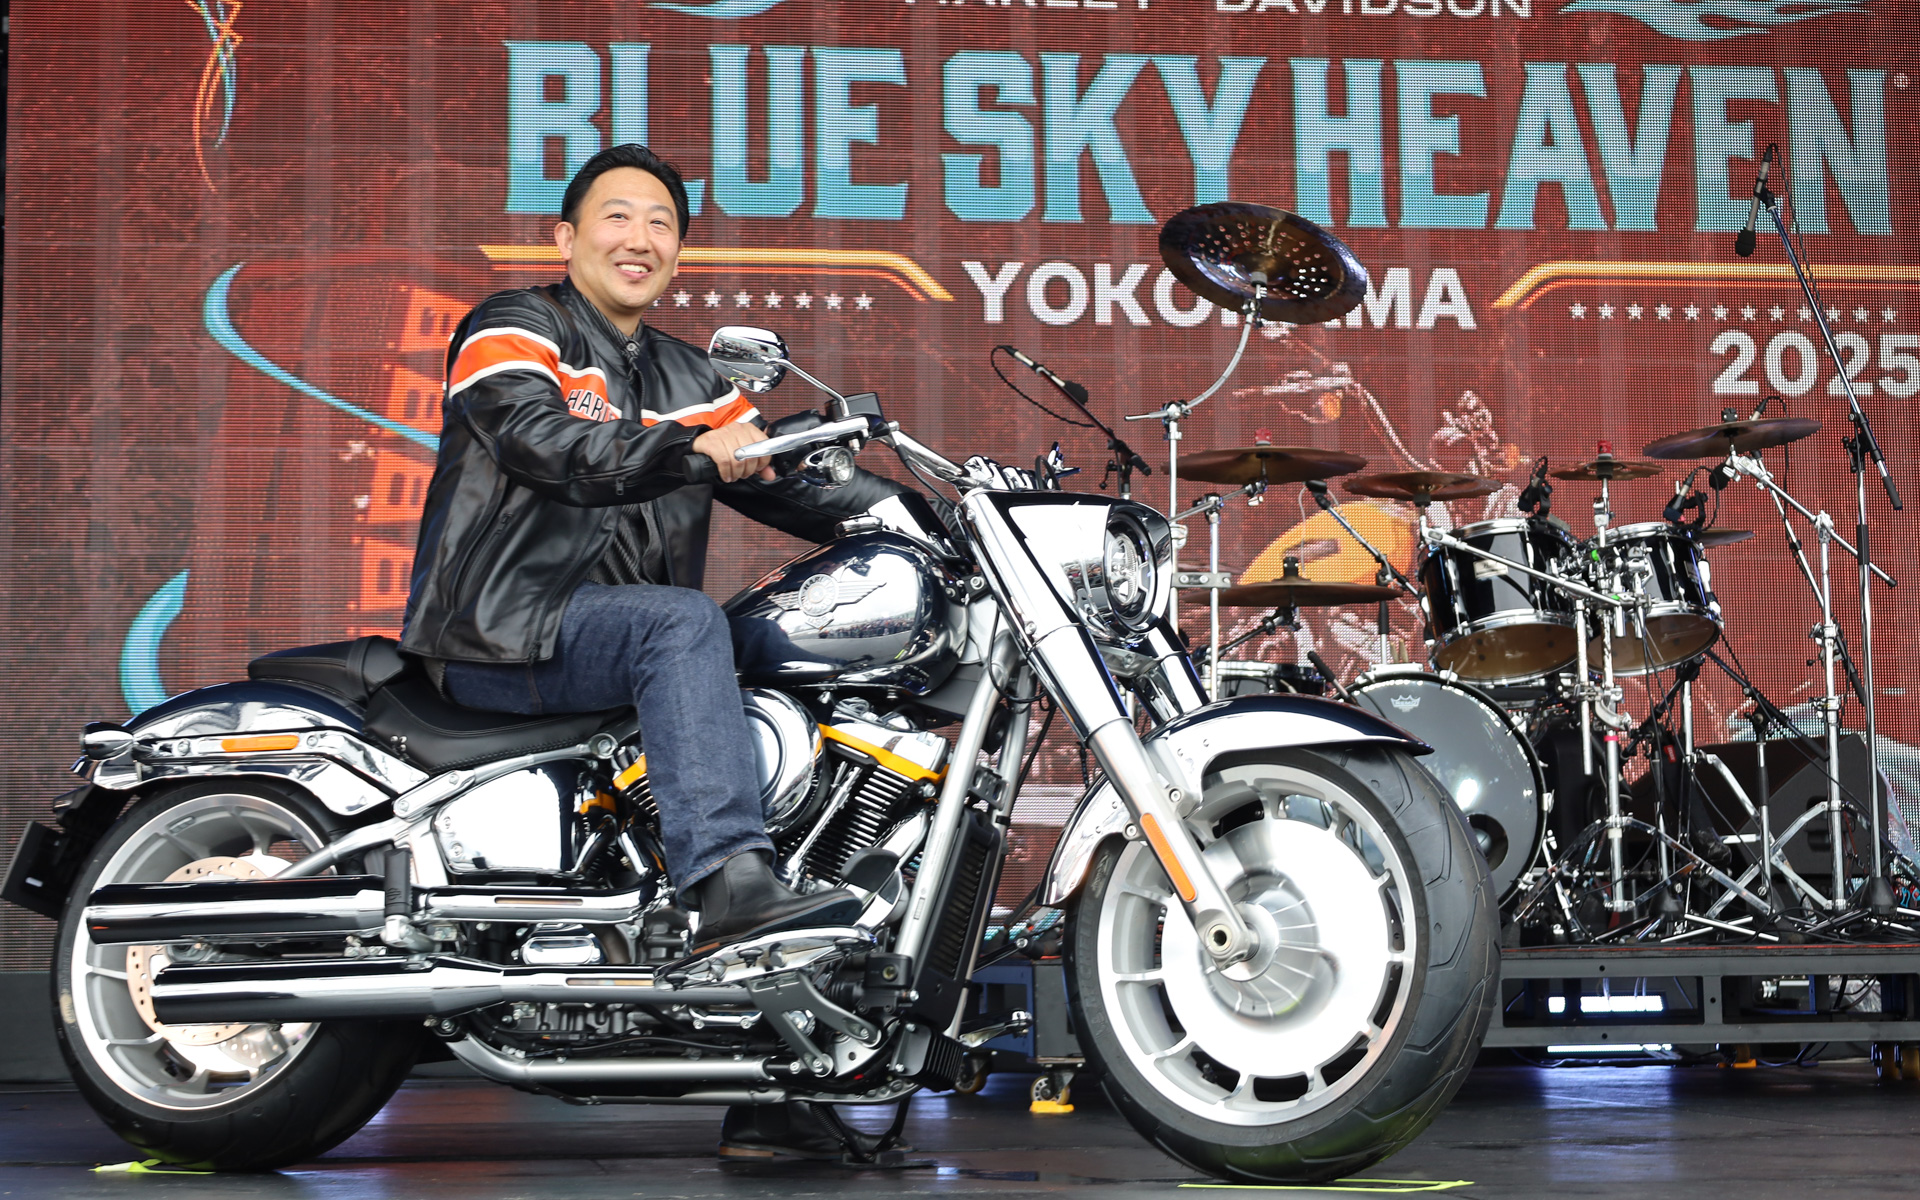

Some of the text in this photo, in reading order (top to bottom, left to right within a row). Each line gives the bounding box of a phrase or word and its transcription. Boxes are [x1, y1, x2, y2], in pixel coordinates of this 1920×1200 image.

[502, 40, 1892, 236] BLUE SKY HEAVEN
[961, 260, 1477, 330] YOKOMA
[1709, 329, 1920, 398] 2025
